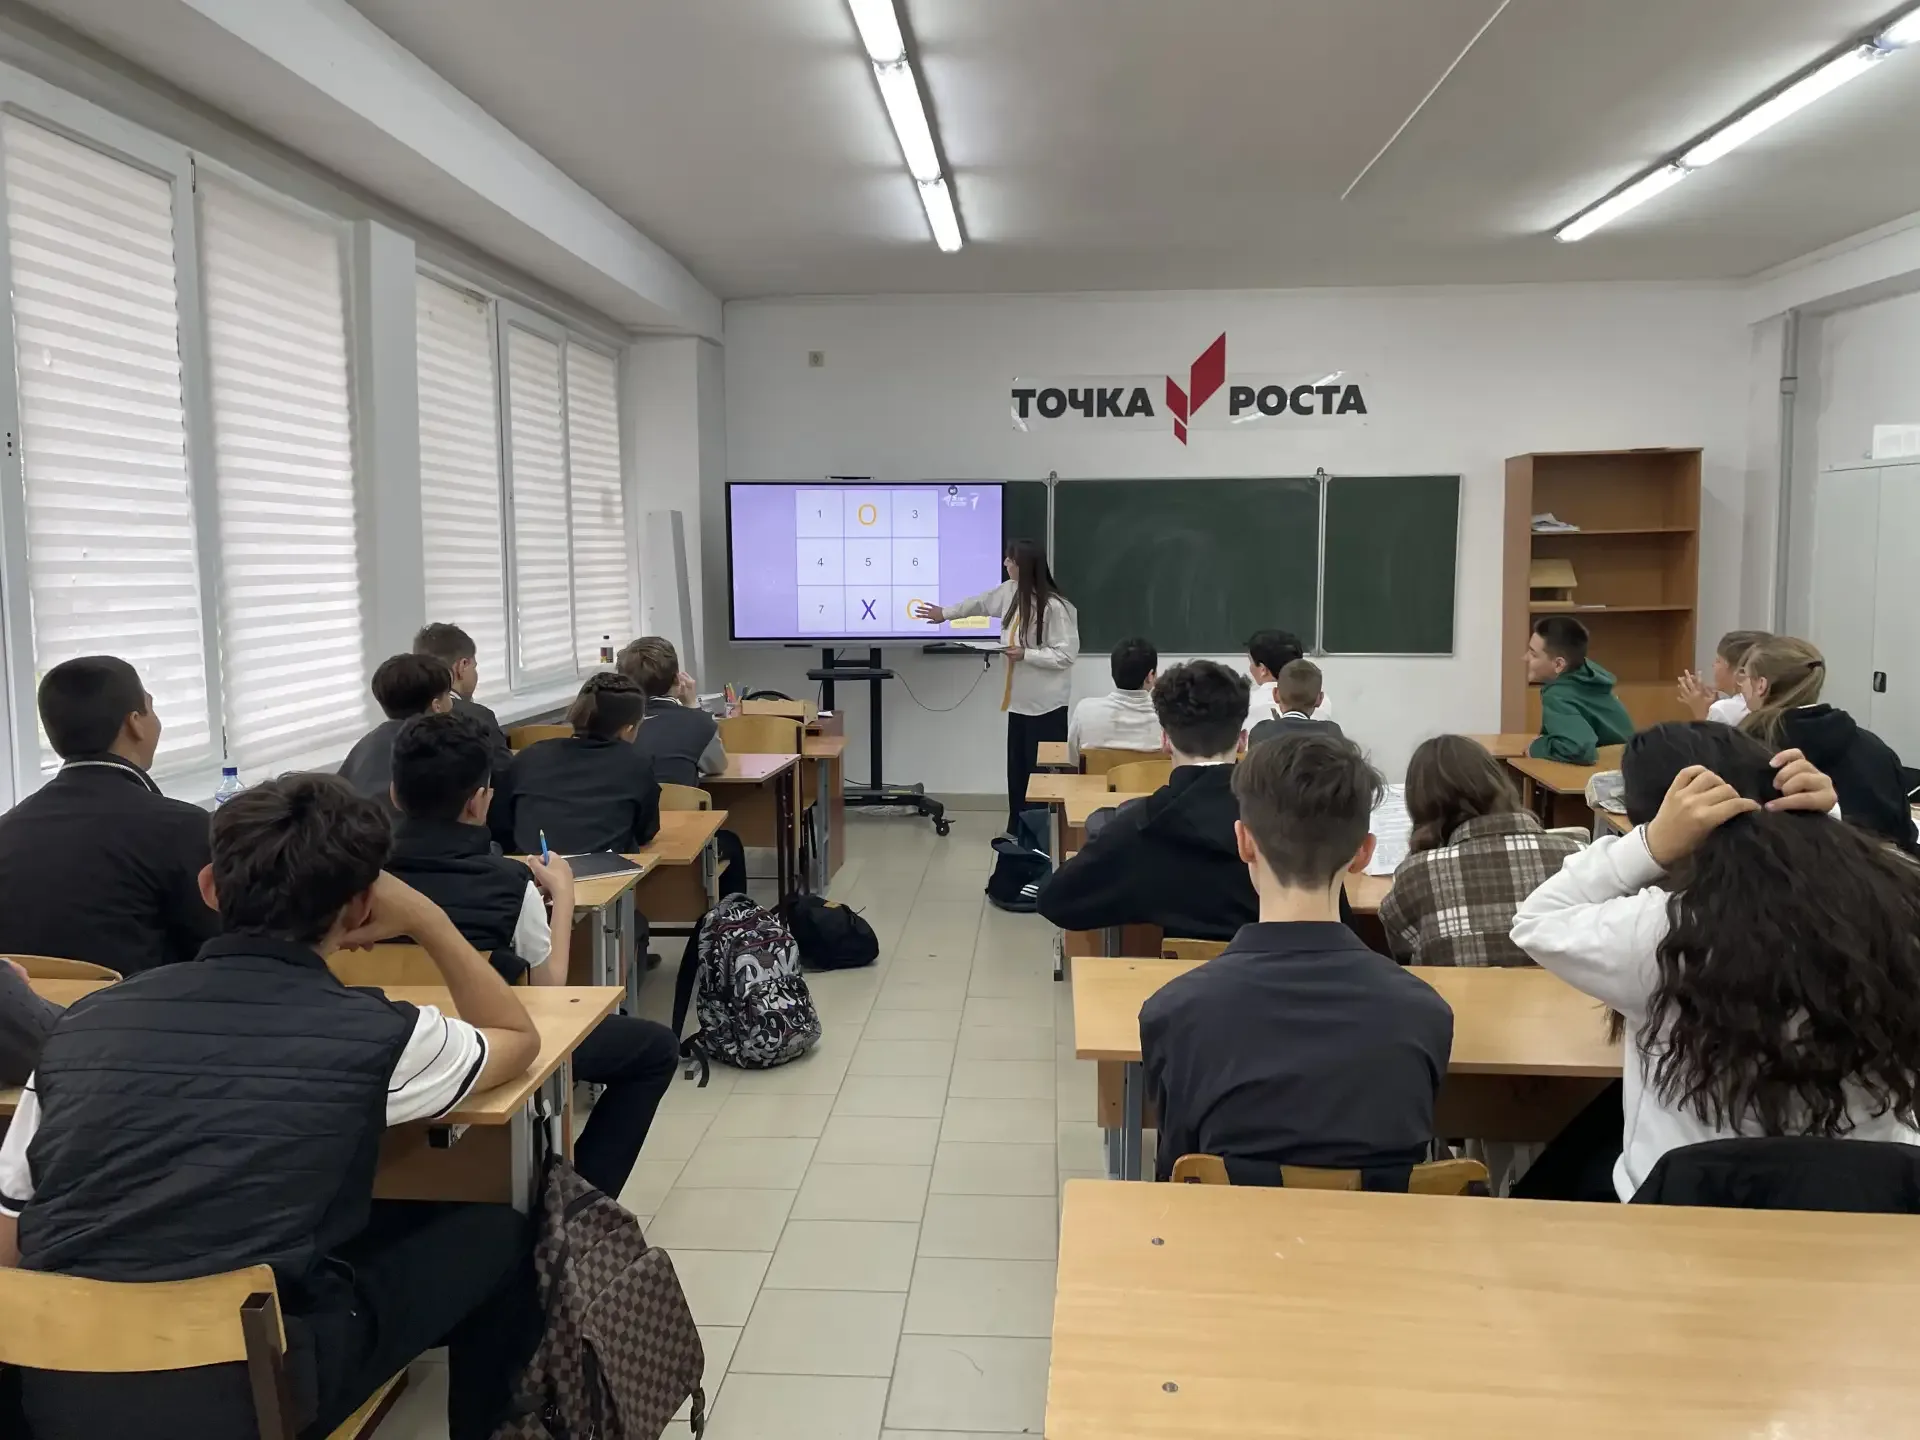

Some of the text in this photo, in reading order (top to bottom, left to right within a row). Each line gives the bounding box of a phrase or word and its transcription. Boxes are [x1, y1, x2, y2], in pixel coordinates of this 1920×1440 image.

[1012, 384, 1368, 418] ТОЧКА РОСТА
[911, 509, 919, 519] 3
[817, 557, 919, 567] 4 5 6
[818, 604, 825, 614] 7
[861, 599, 876, 620] X
